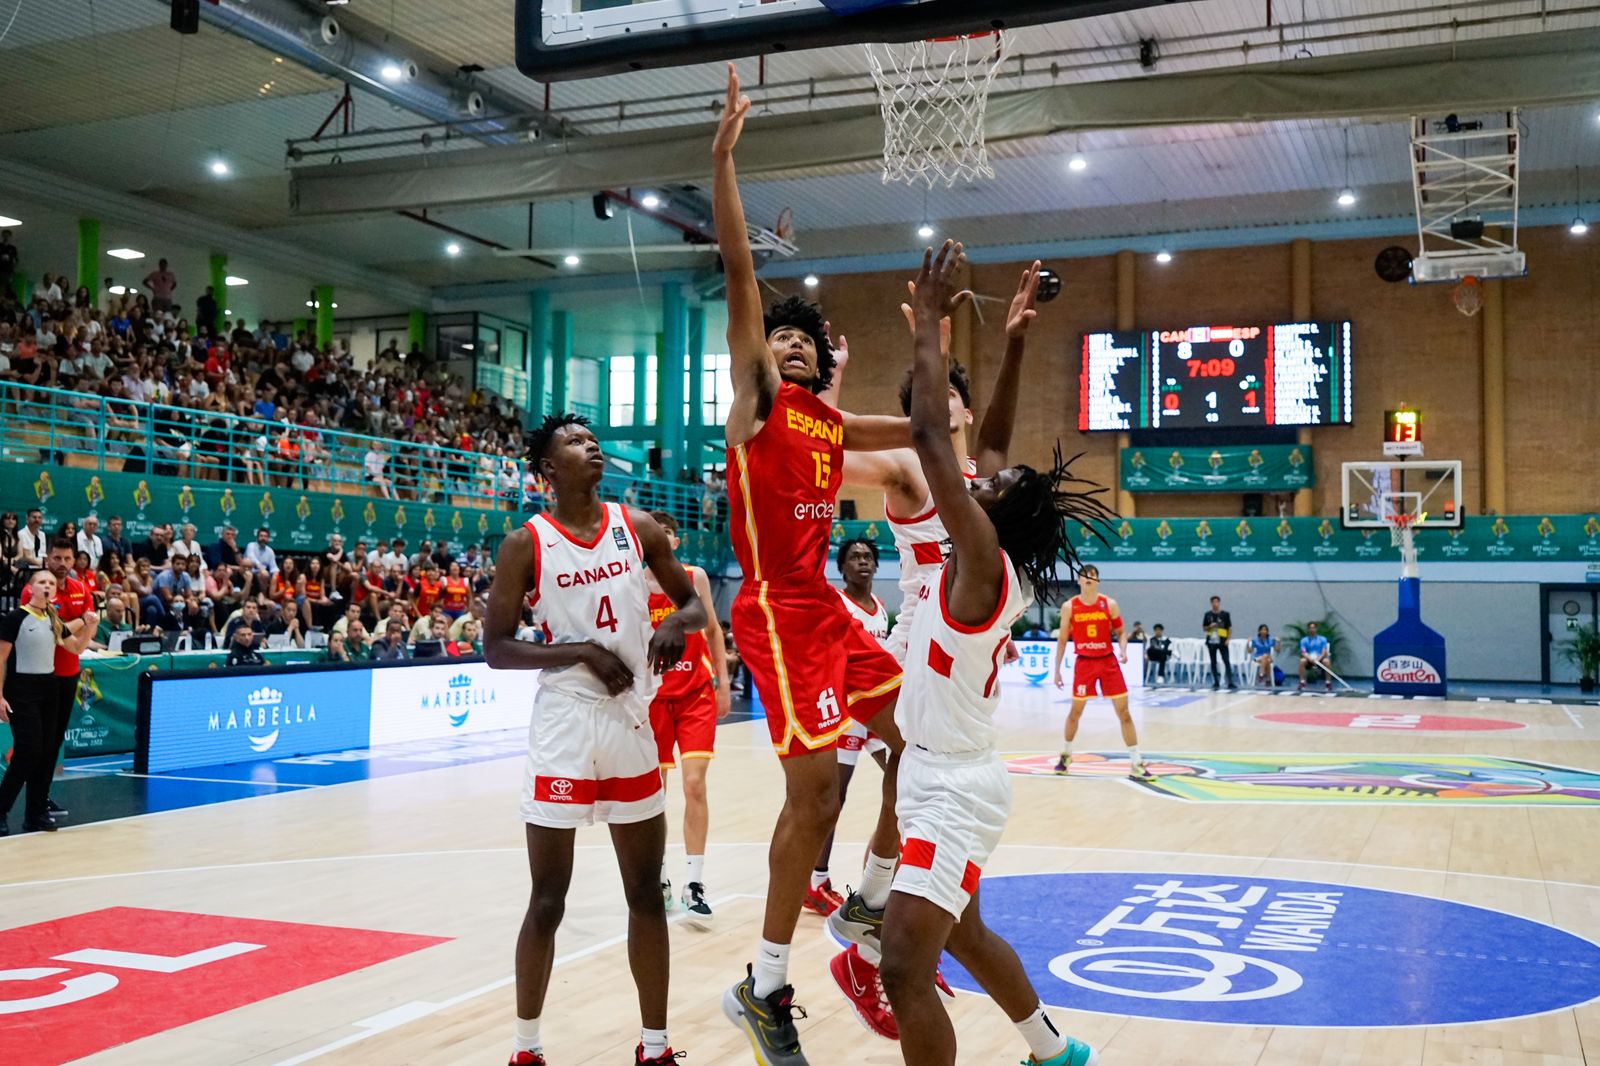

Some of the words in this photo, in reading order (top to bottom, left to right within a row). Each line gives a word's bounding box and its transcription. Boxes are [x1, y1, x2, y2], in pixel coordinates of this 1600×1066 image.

[1160, 331, 1189, 343] CAN
[1177, 342, 1192, 360] 8
[1229, 339, 1244, 357] 0
[1186, 358, 1235, 378] 7:09
[1164, 393, 1179, 410] 0
[1205, 391, 1217, 409] 1
[1244, 390, 1256, 407] 1
[1395, 423, 1416, 442] 13
[557, 559, 632, 588] CANADA
[595, 594, 618, 633] 4
[1087, 624, 1097, 638] 6
[421, 687, 498, 711] MARBELLA
[208, 703, 317, 732] MARBELLA
[64, 728, 81, 741] U17
[1239, 890, 1344, 952] WANDA
